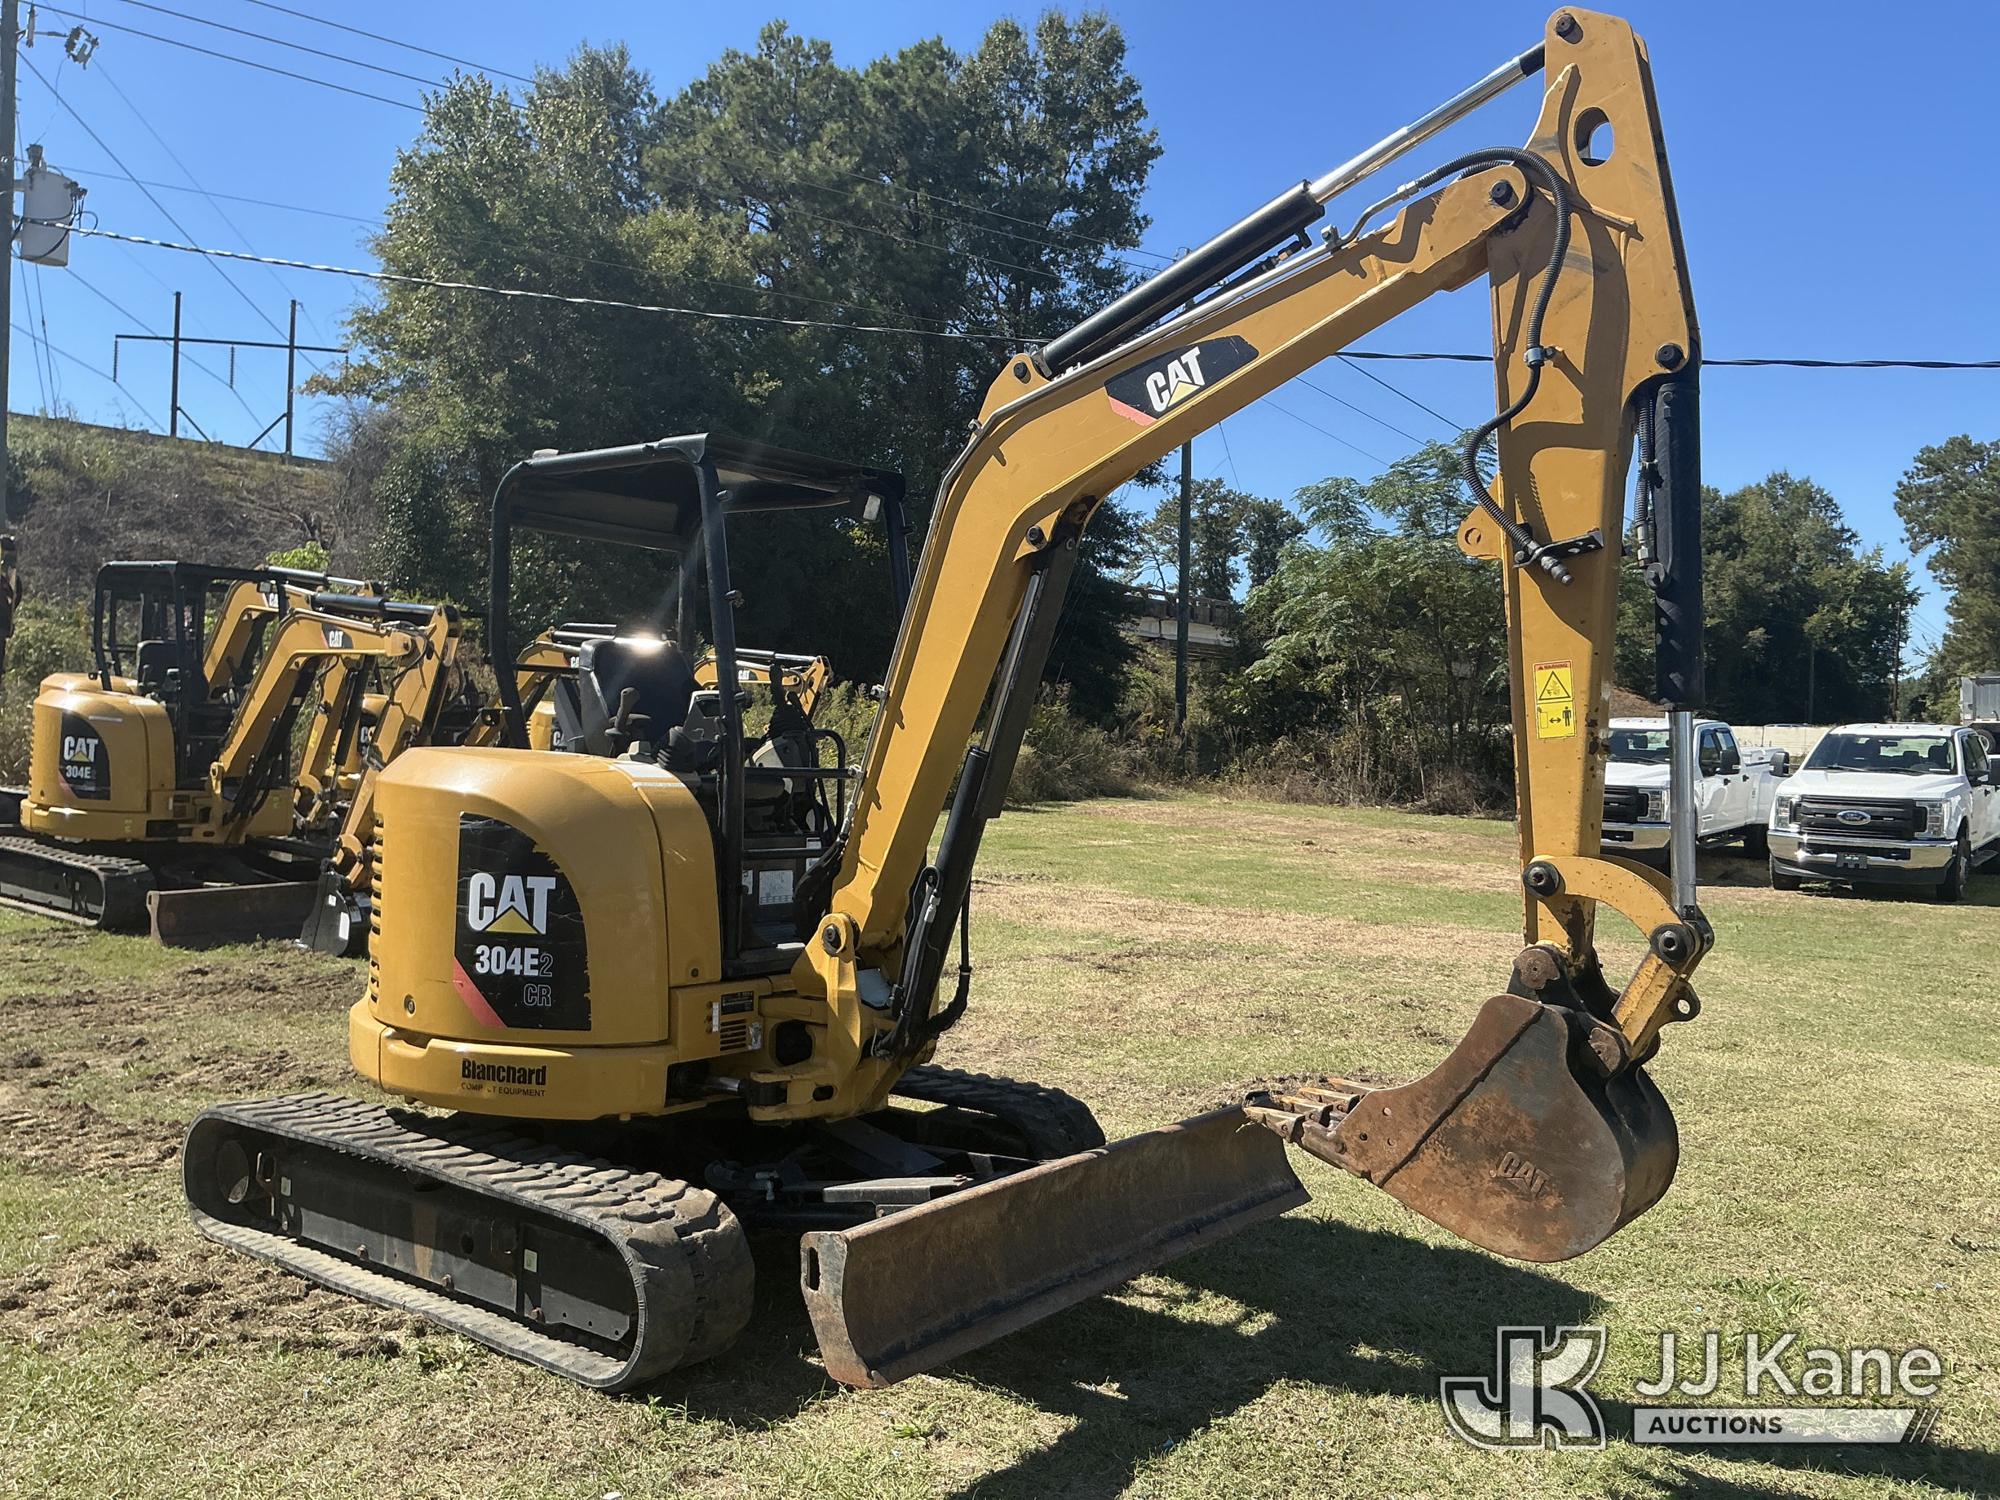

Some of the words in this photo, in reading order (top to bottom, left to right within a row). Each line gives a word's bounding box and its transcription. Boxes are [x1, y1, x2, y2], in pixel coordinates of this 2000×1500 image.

[1146, 346, 1205, 412] CAT
[329, 630, 344, 648] CAT
[63, 736, 99, 762] CAT
[468, 872, 556, 934] CAT
[475, 945, 553, 977] 304E2
[523, 983, 552, 1007] CR
[498, 1086, 545, 1097] EQUIPMENT
[1496, 1151, 1552, 1198] CAT
